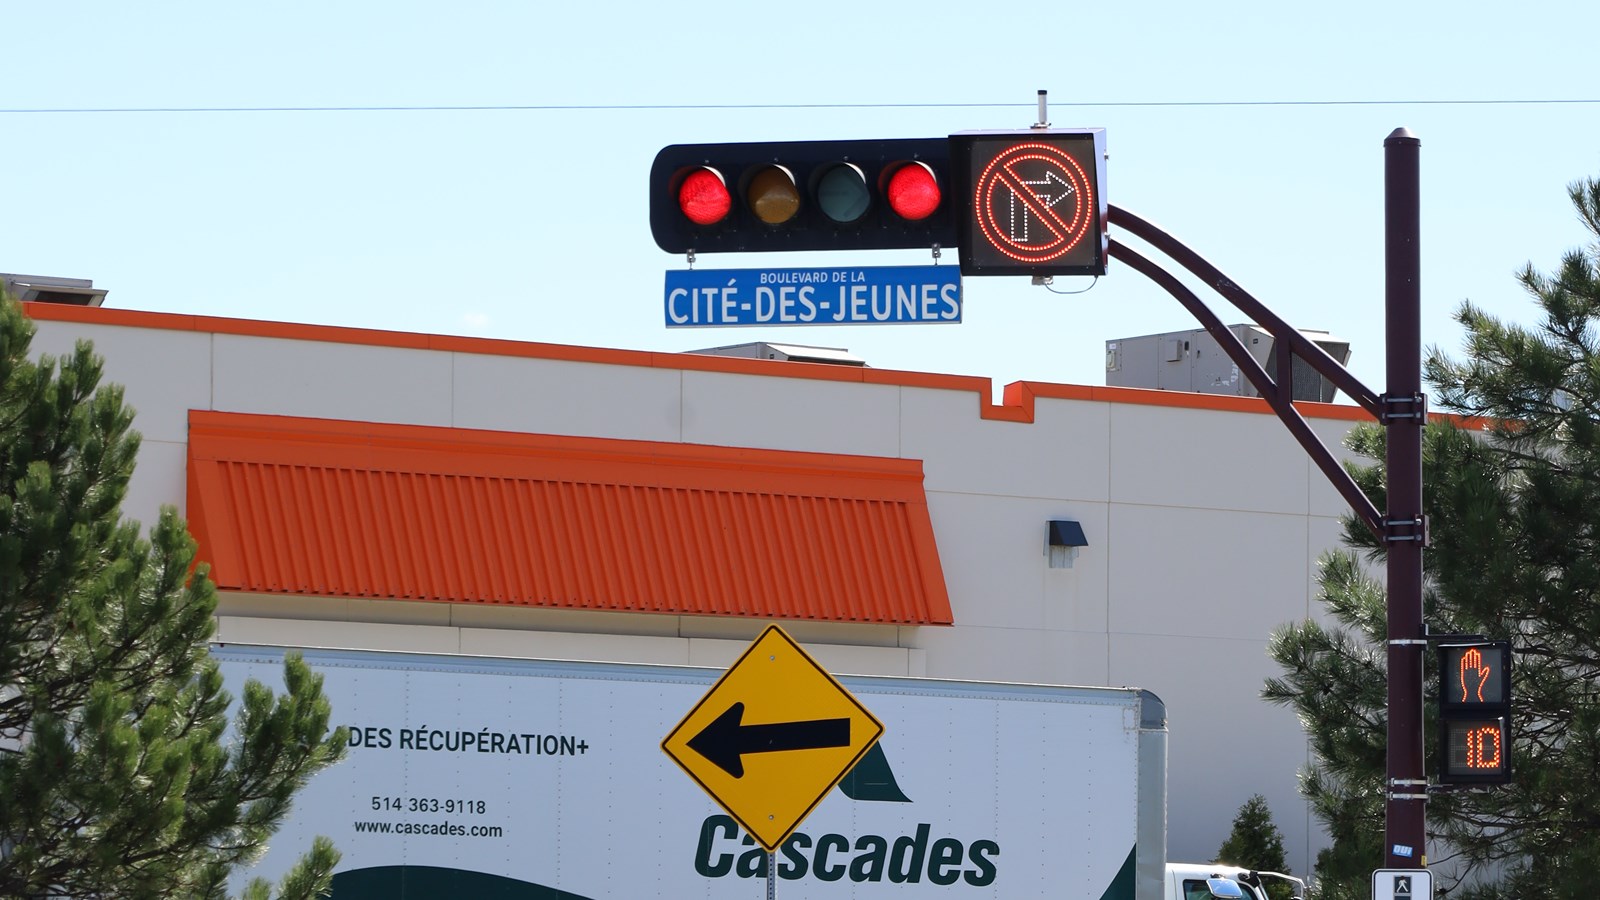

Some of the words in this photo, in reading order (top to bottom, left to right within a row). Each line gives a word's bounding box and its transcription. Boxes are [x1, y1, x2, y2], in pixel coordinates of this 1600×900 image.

[760, 271, 827, 283] BOULEVARD
[831, 271, 849, 282] DE
[851, 271, 866, 282] LA
[668, 278, 959, 324] CITÉ-DES-JEUNES
[400, 725, 589, 756] RÉCUPÉRATION+
[1467, 727, 1500, 768] 10
[371, 796, 402, 811] 514
[408, 798, 486, 814] 363-9118
[354, 821, 503, 837] www.cascades.com
[694, 814, 1000, 887] Cascades
